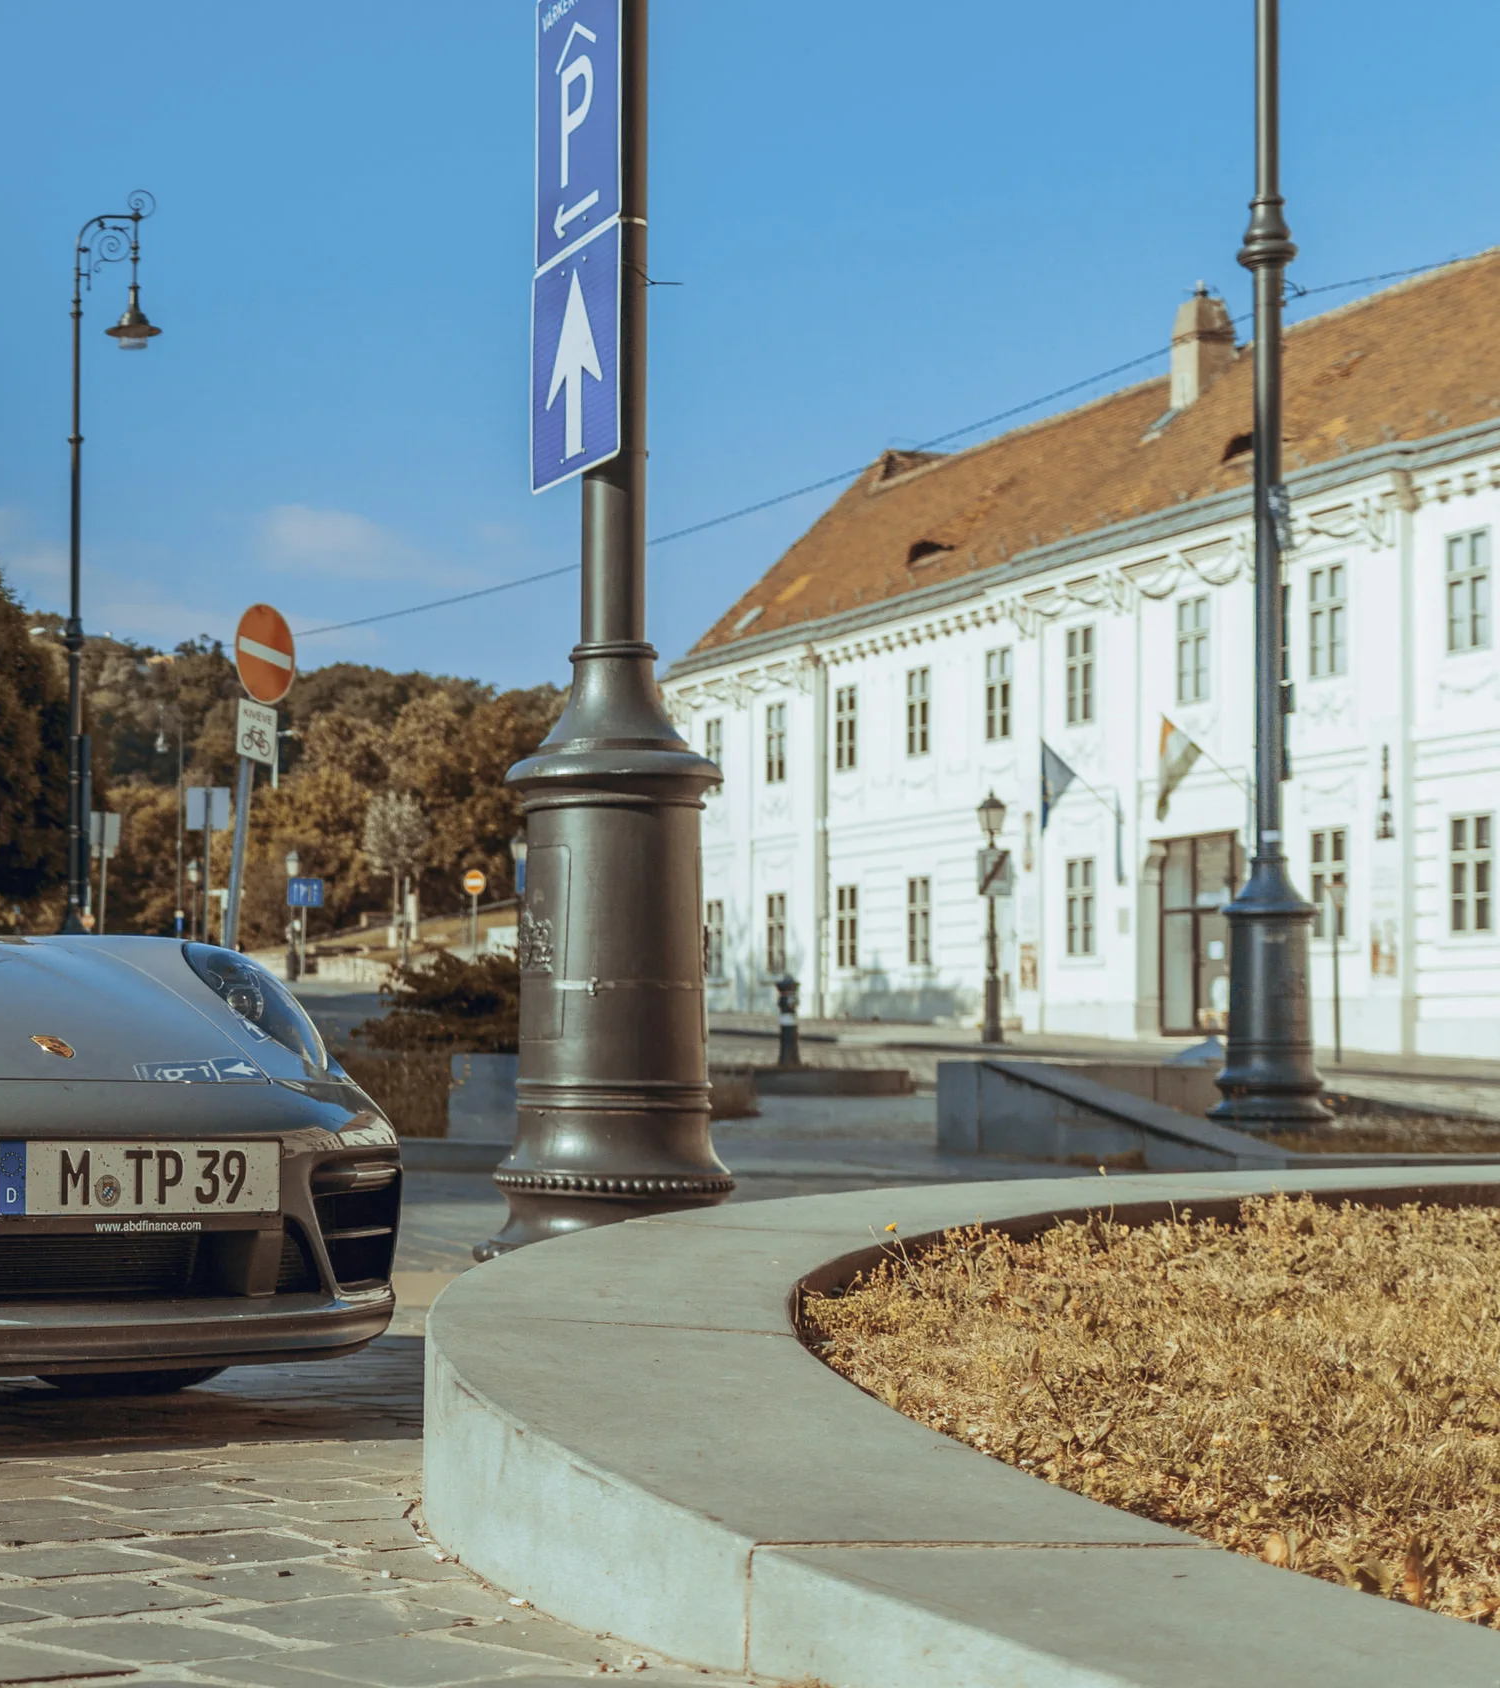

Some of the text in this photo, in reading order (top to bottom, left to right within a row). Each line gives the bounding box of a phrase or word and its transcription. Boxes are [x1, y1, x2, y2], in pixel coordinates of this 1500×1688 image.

[561, 55, 594, 188] P
[6, 1187, 17, 1203] D
[61, 1150, 247, 1205] M TP 39
[95, 1220, 202, 1232] www.abdfinance.com
